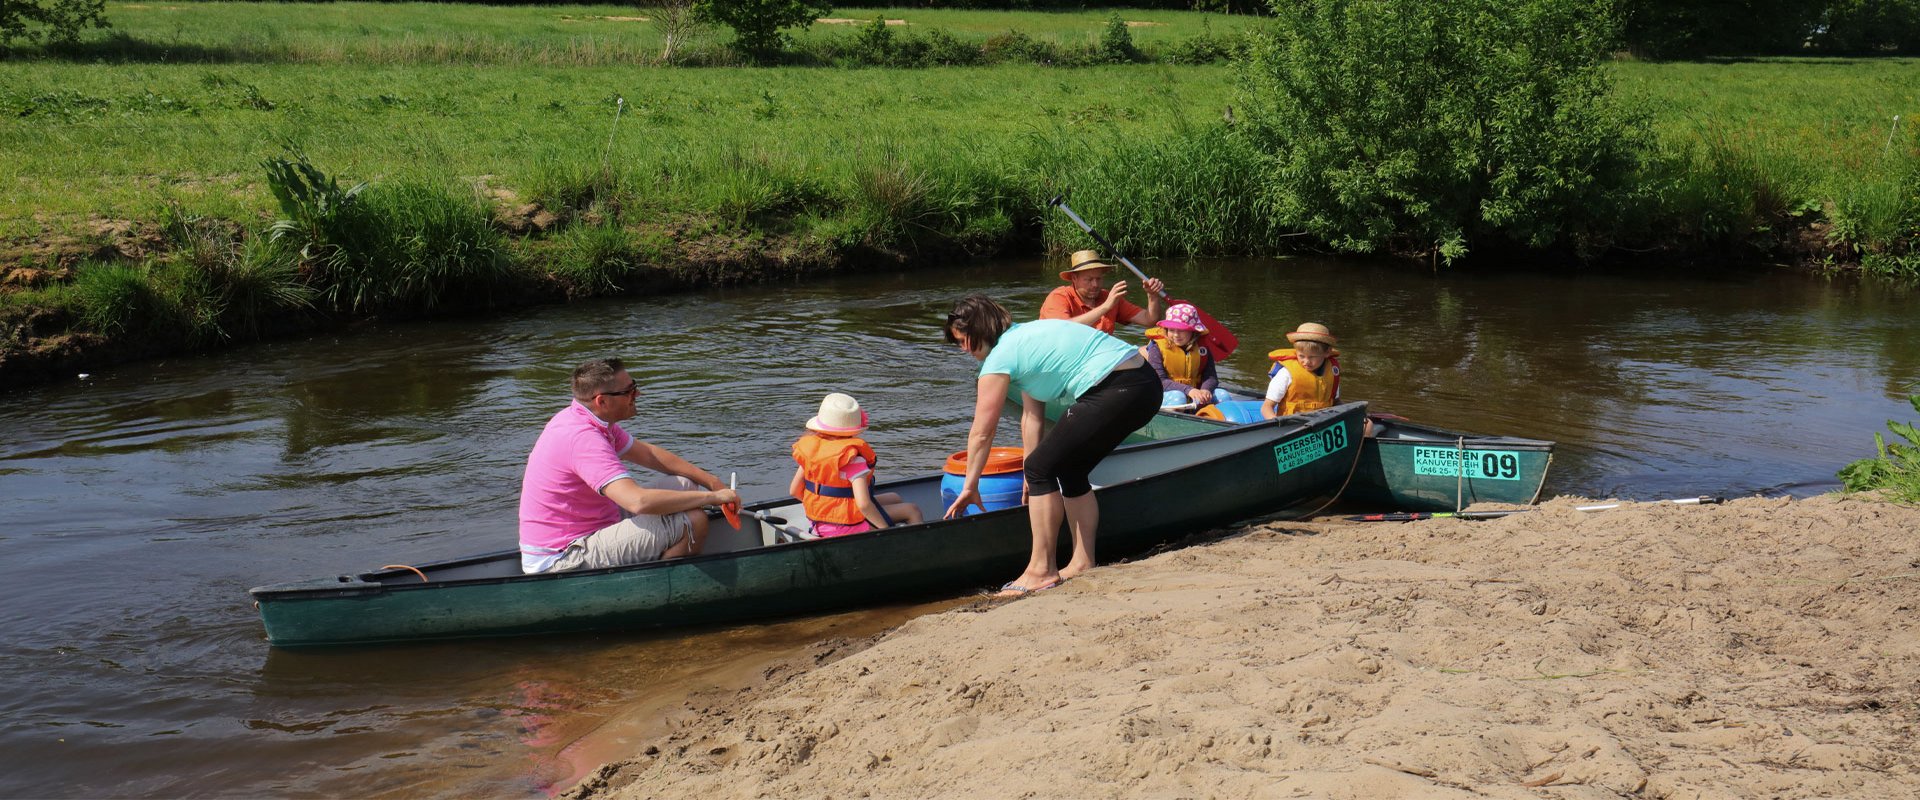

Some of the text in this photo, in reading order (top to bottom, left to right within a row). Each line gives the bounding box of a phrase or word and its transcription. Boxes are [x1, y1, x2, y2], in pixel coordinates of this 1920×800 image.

[1276, 432, 1322, 455] PETERSEN
[1322, 425, 1344, 452] 08
[1278, 442, 1323, 464] KANUVERLEIH
[1416, 449, 1478, 460] PETERSEN
[1416, 459, 1479, 468] KANUVEREIH
[1482, 453, 1517, 478] 09
